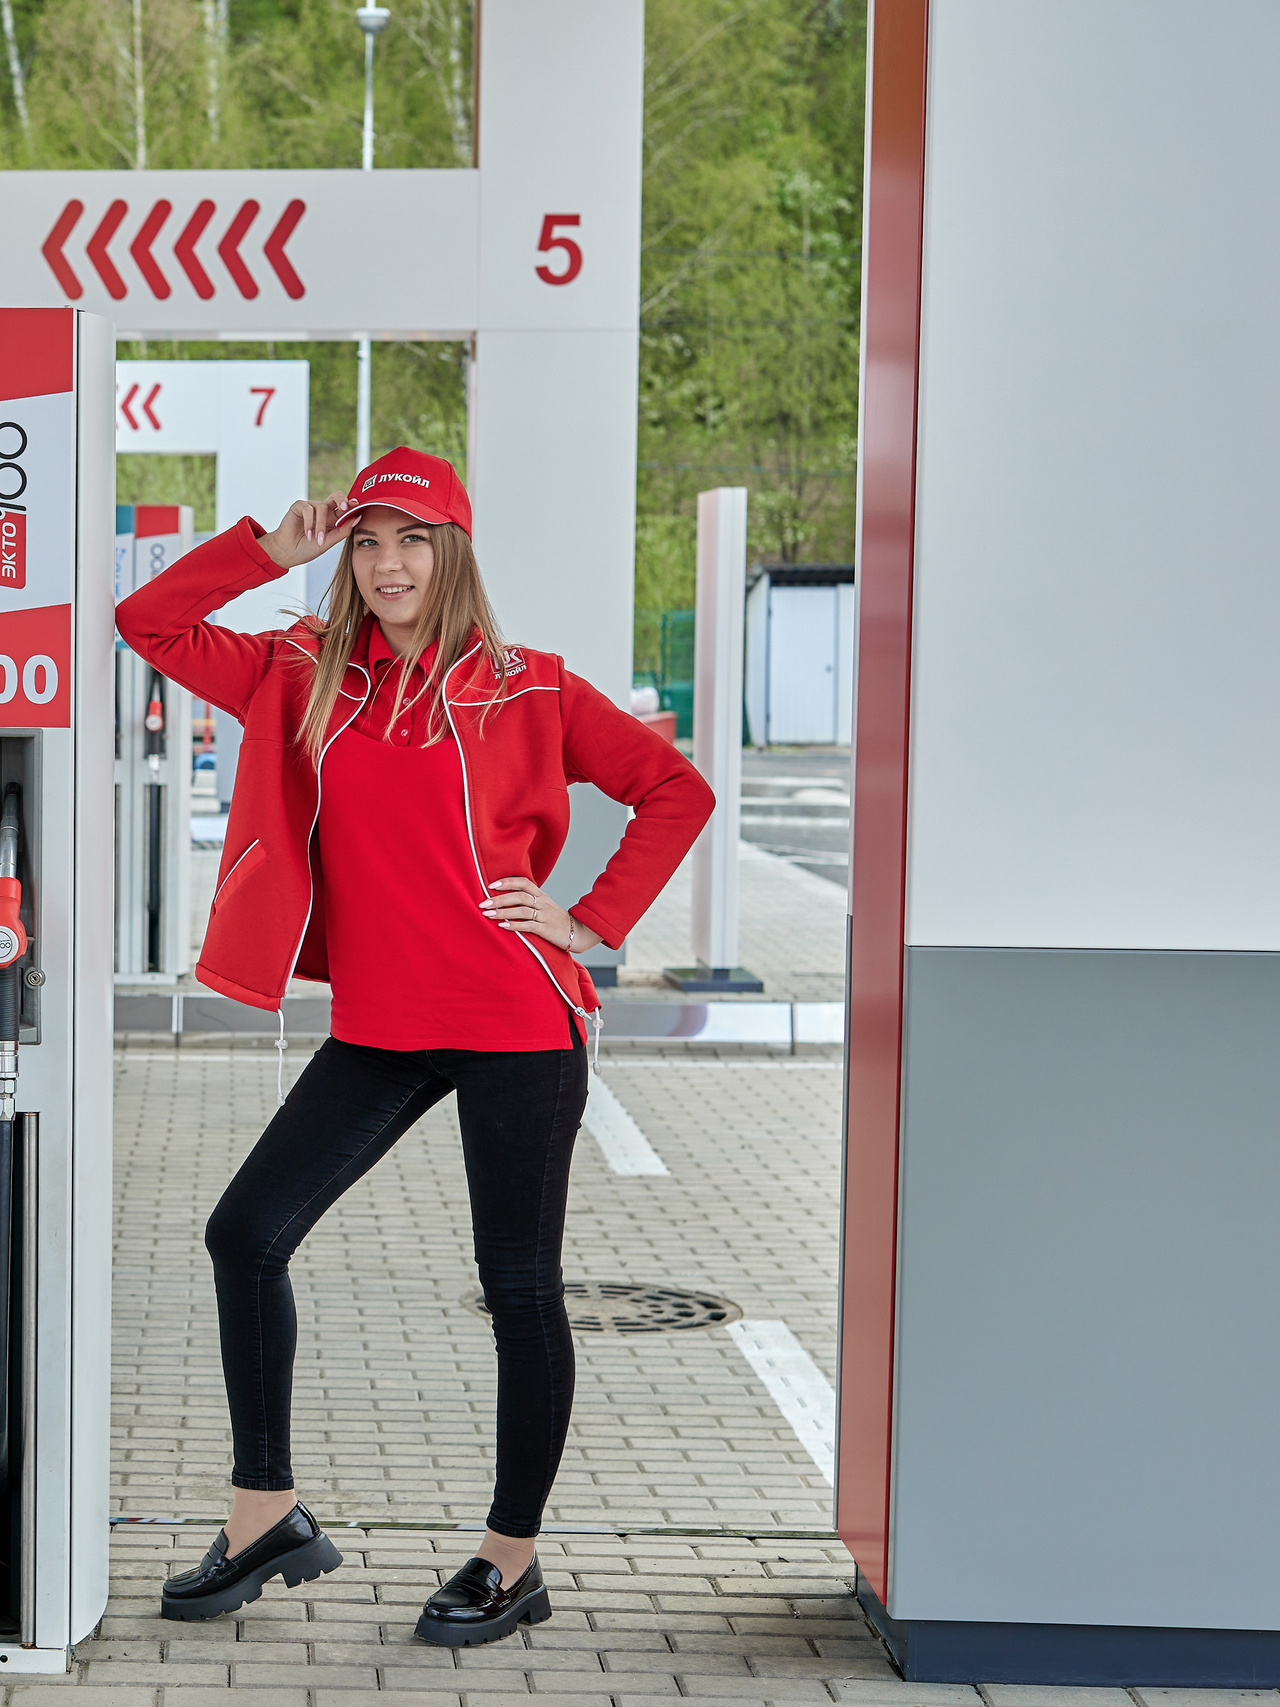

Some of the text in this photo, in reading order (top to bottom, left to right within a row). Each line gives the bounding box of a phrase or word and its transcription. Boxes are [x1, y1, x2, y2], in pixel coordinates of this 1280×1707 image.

[535, 213, 583, 286] 5
[249, 387, 276, 427] 7
[378, 473, 430, 488] ЛУКОЙЛ
[1, 522, 17, 579] ЭКТО
[495, 664, 527, 680] ЛКОЙЛ
